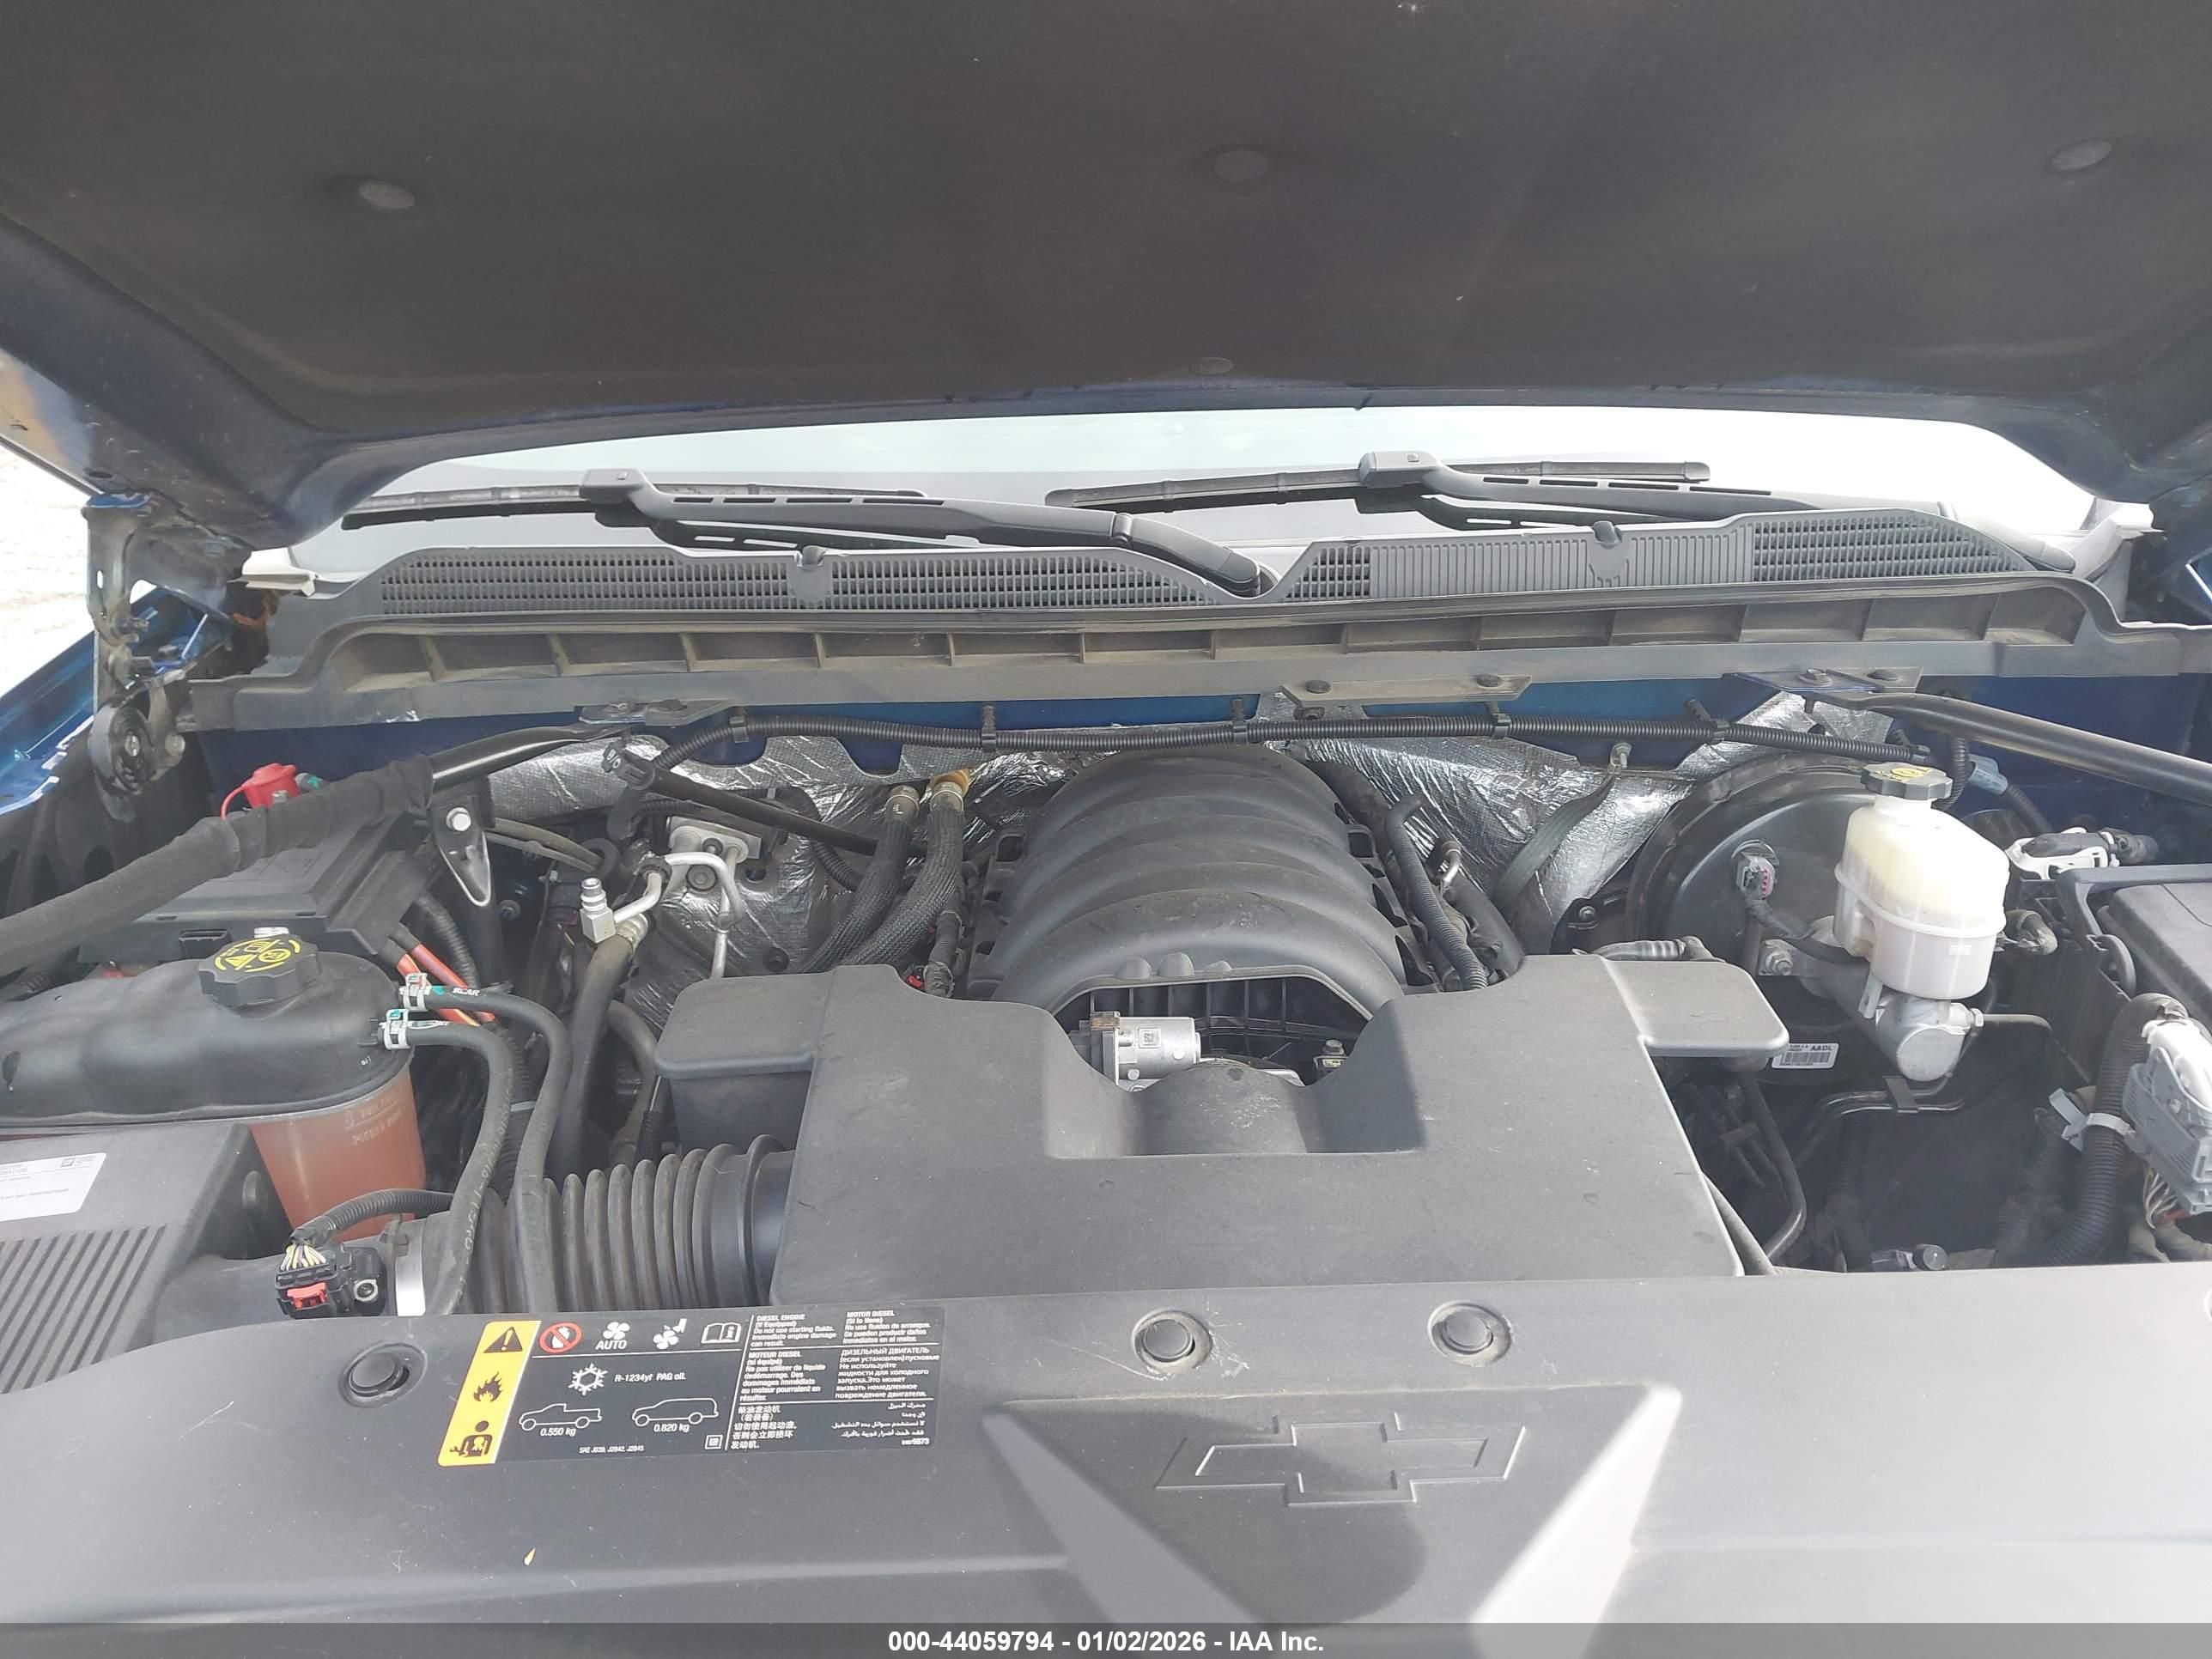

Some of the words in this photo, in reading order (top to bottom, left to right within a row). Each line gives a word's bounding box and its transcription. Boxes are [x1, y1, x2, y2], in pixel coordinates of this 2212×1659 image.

[595, 1340, 627, 1350] AUTO
[615, 1373, 653, 1382] R-1234yf
[565, 1427, 576, 1437] kg
[654, 1424, 678, 1432] 0.820
[679, 1424, 690, 1432] kg
